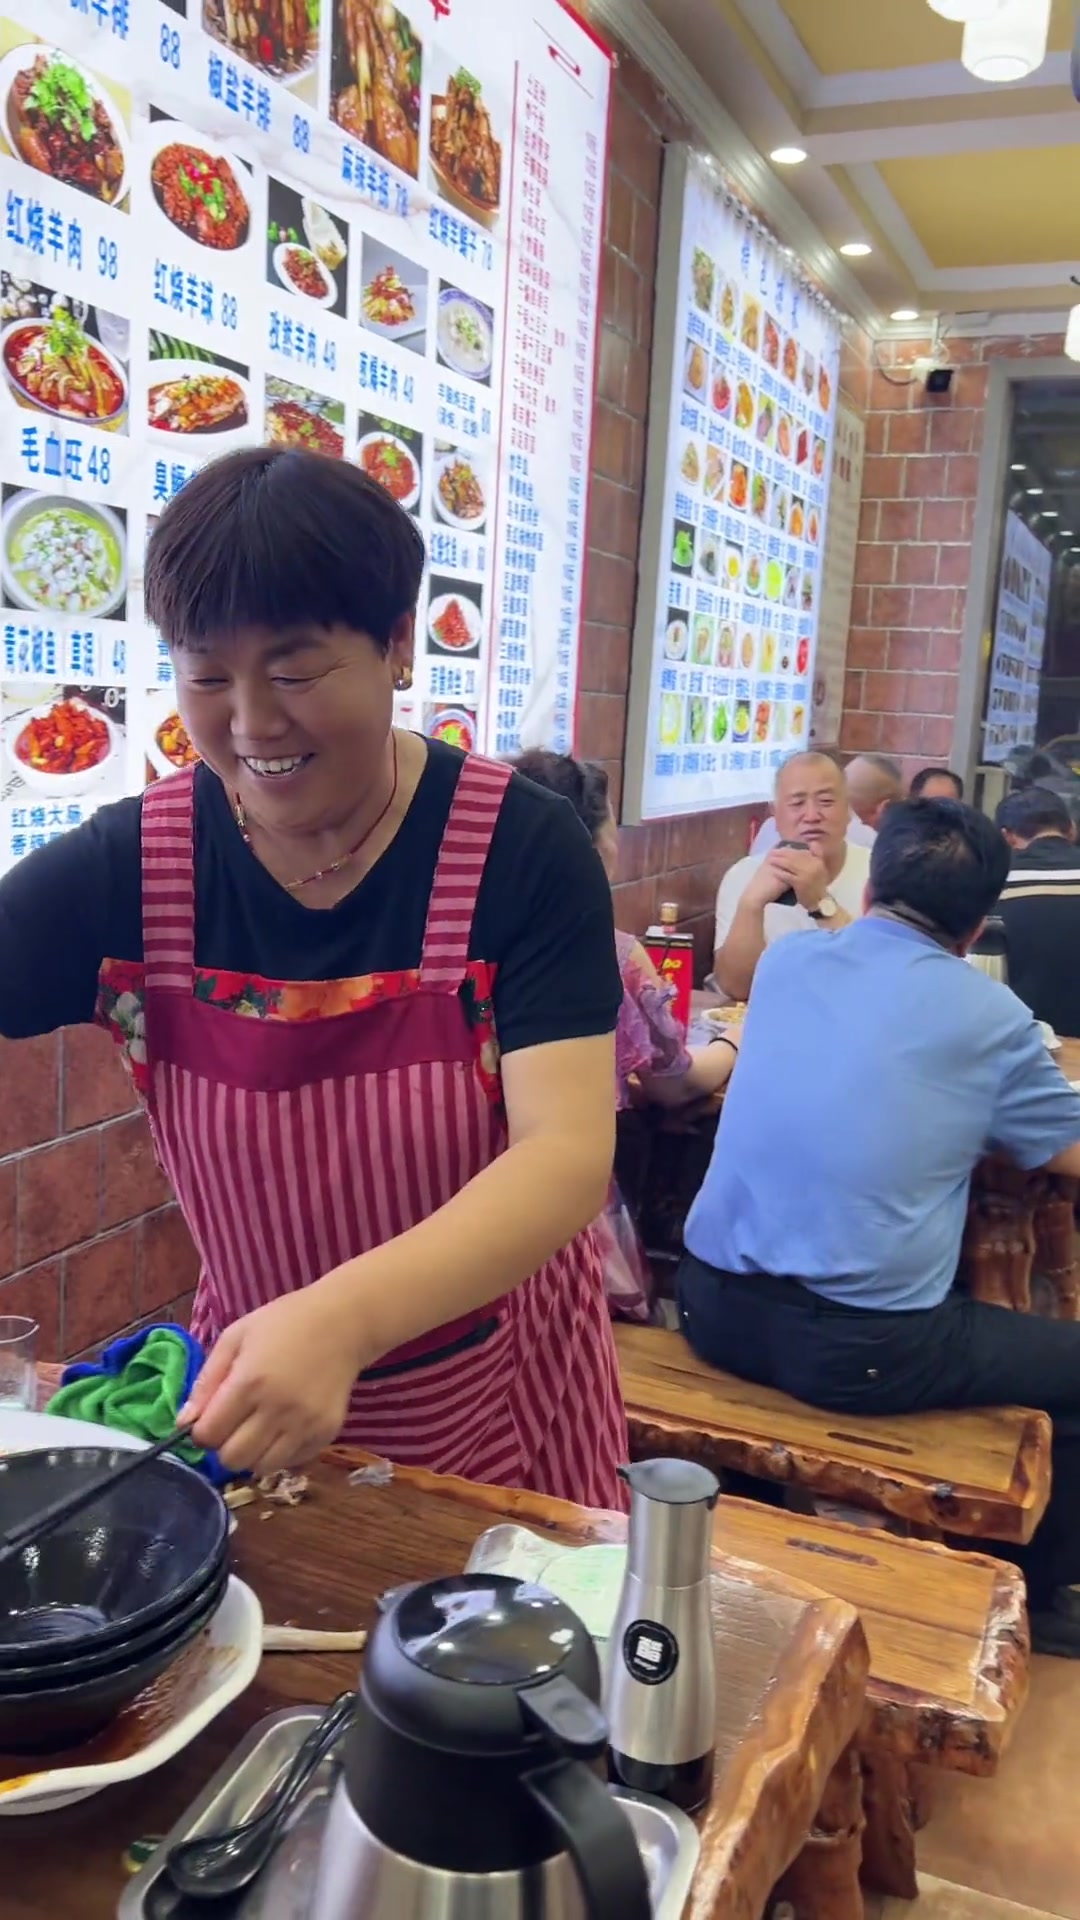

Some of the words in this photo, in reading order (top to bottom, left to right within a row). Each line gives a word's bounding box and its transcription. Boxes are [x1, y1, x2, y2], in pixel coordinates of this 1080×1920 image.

[160, 22, 181, 69] 88
[208, 50, 271, 133] 椒盐羊排
[293, 113, 311, 154] 88
[395, 183, 408, 217] 78
[6, 189, 82, 272] 红烧羊肉
[98, 235, 118, 280] 98
[221, 291, 237, 331] 88
[322, 338, 337, 373] 48
[402, 374, 414, 404] 48
[21, 426, 83, 483] 毛血旺
[88, 444, 111, 485] 48
[4, 624, 56, 675] 青花椒鱼
[113, 639, 126, 675] 48
[11, 832, 65, 857] 香辣
